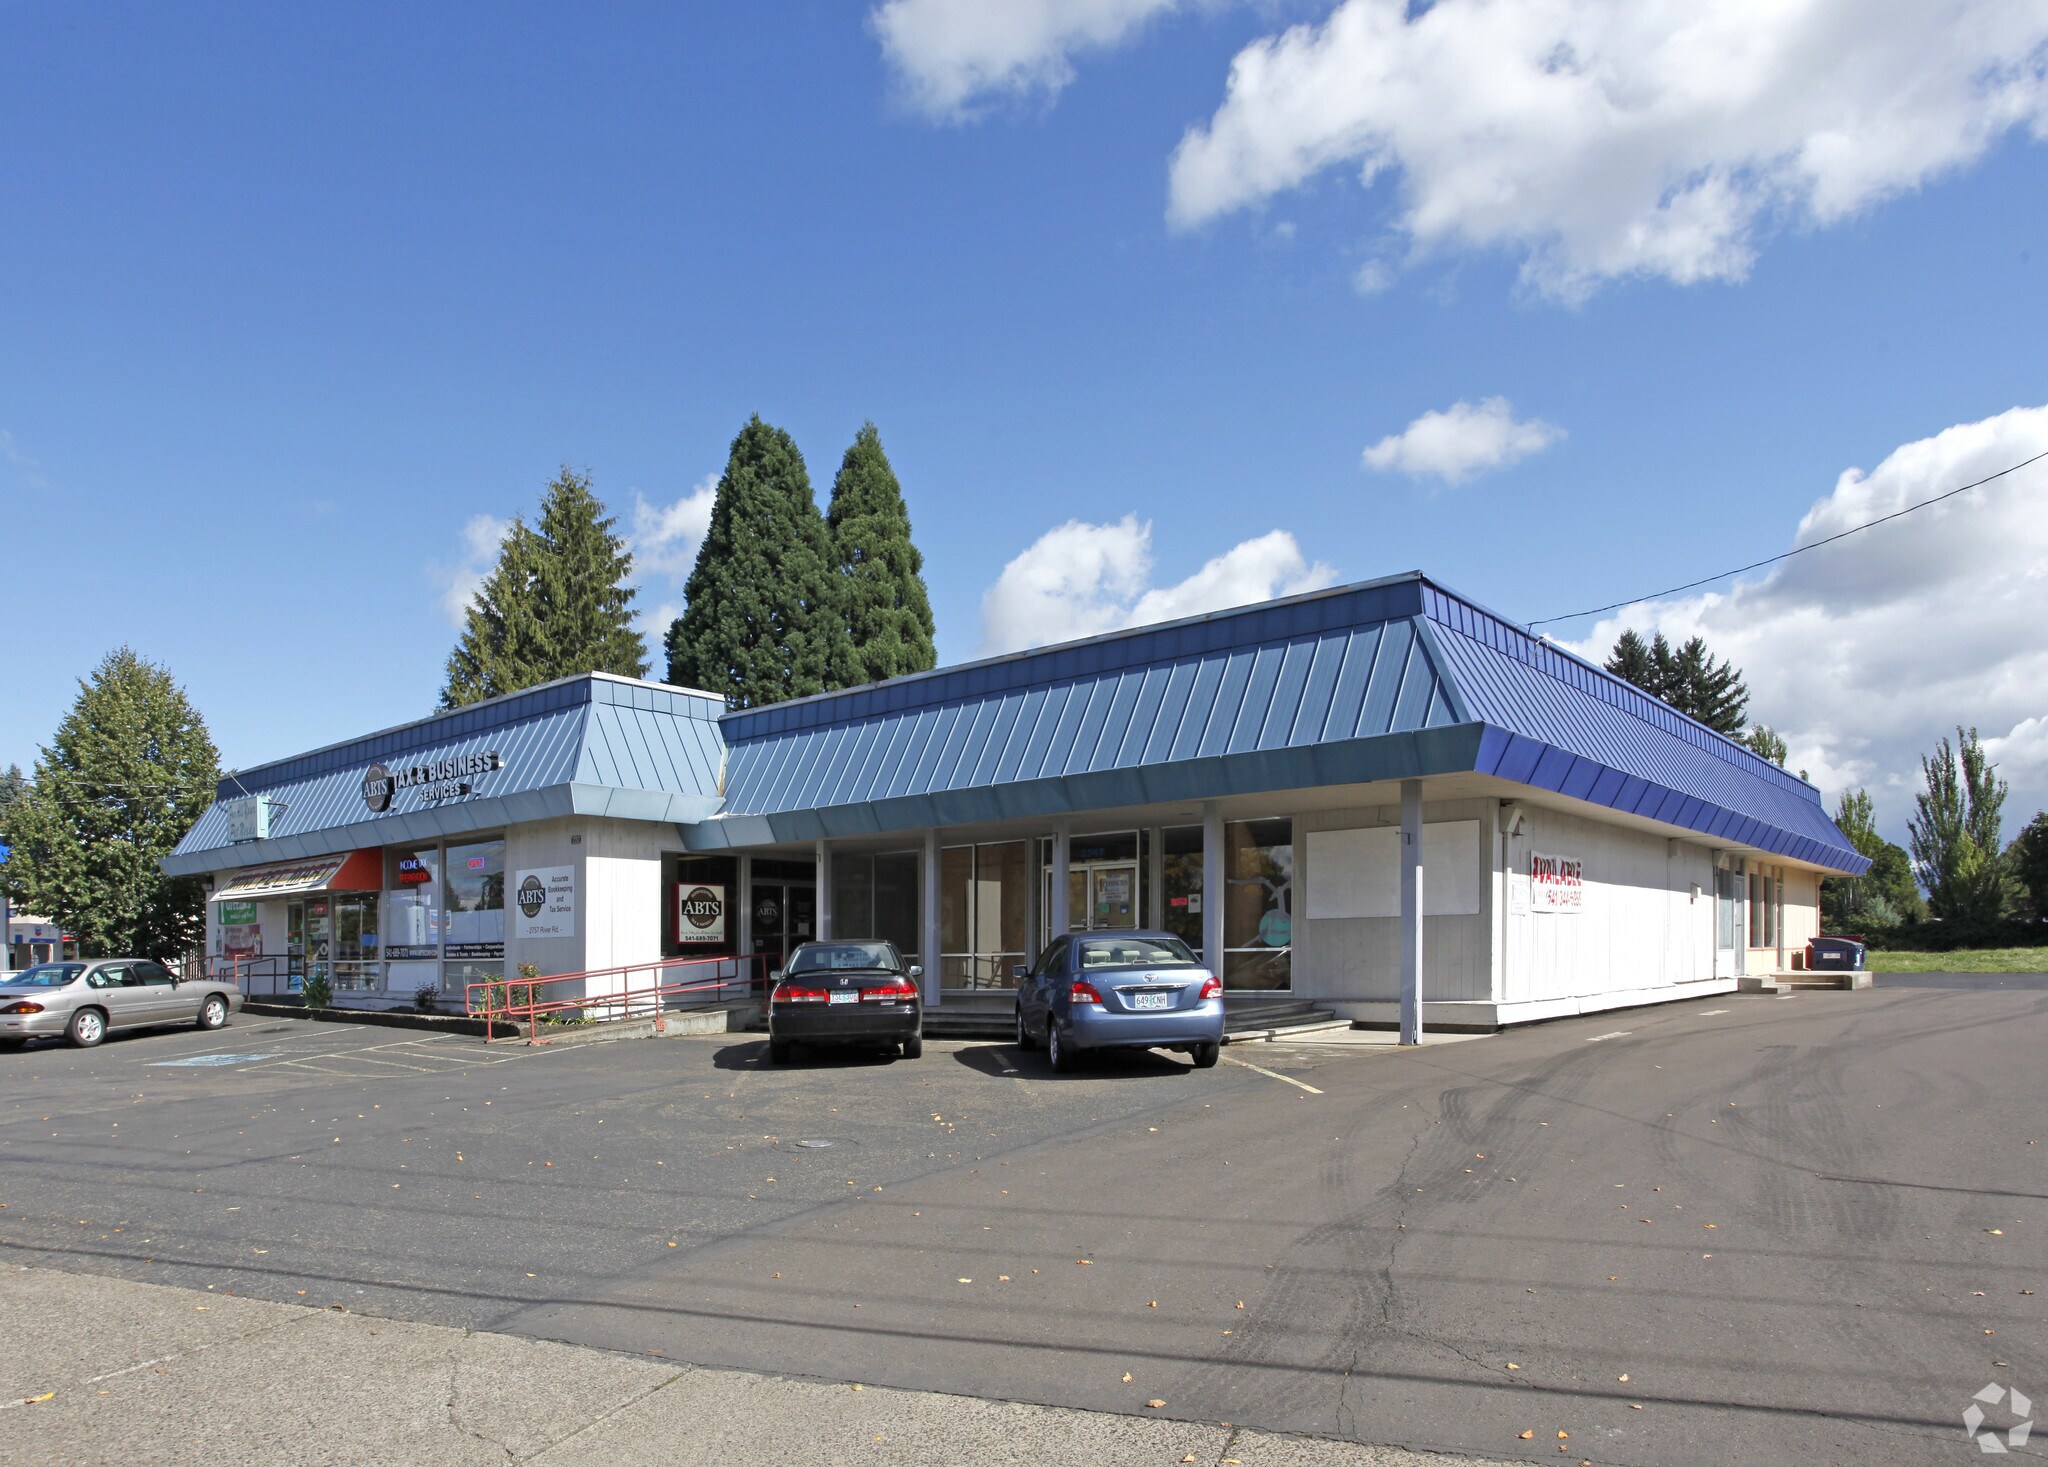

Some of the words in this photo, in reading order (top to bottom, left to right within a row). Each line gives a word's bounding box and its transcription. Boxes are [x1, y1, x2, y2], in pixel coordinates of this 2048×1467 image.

[393, 768, 414, 788] TAX
[416, 765, 426, 784] &
[429, 750, 493, 782] BUSINESS
[363, 778, 388, 798] ABTS
[418, 783, 461, 801] SERVICES
[400, 859, 418, 870] INCOME
[468, 859, 482, 868] OPEN
[1533, 856, 1582, 887] AVAILABLE
[551, 875, 569, 883] Accurate
[548, 885, 573, 893] Bookkeeping
[519, 889, 544, 904] ABTS
[556, 904, 571, 912] Service
[683, 900, 720, 916] ABTS
[759, 907, 777, 915] ABTS
[1136, 995, 1148, 1005] 649
[1152, 995, 1166, 1004] CNH
